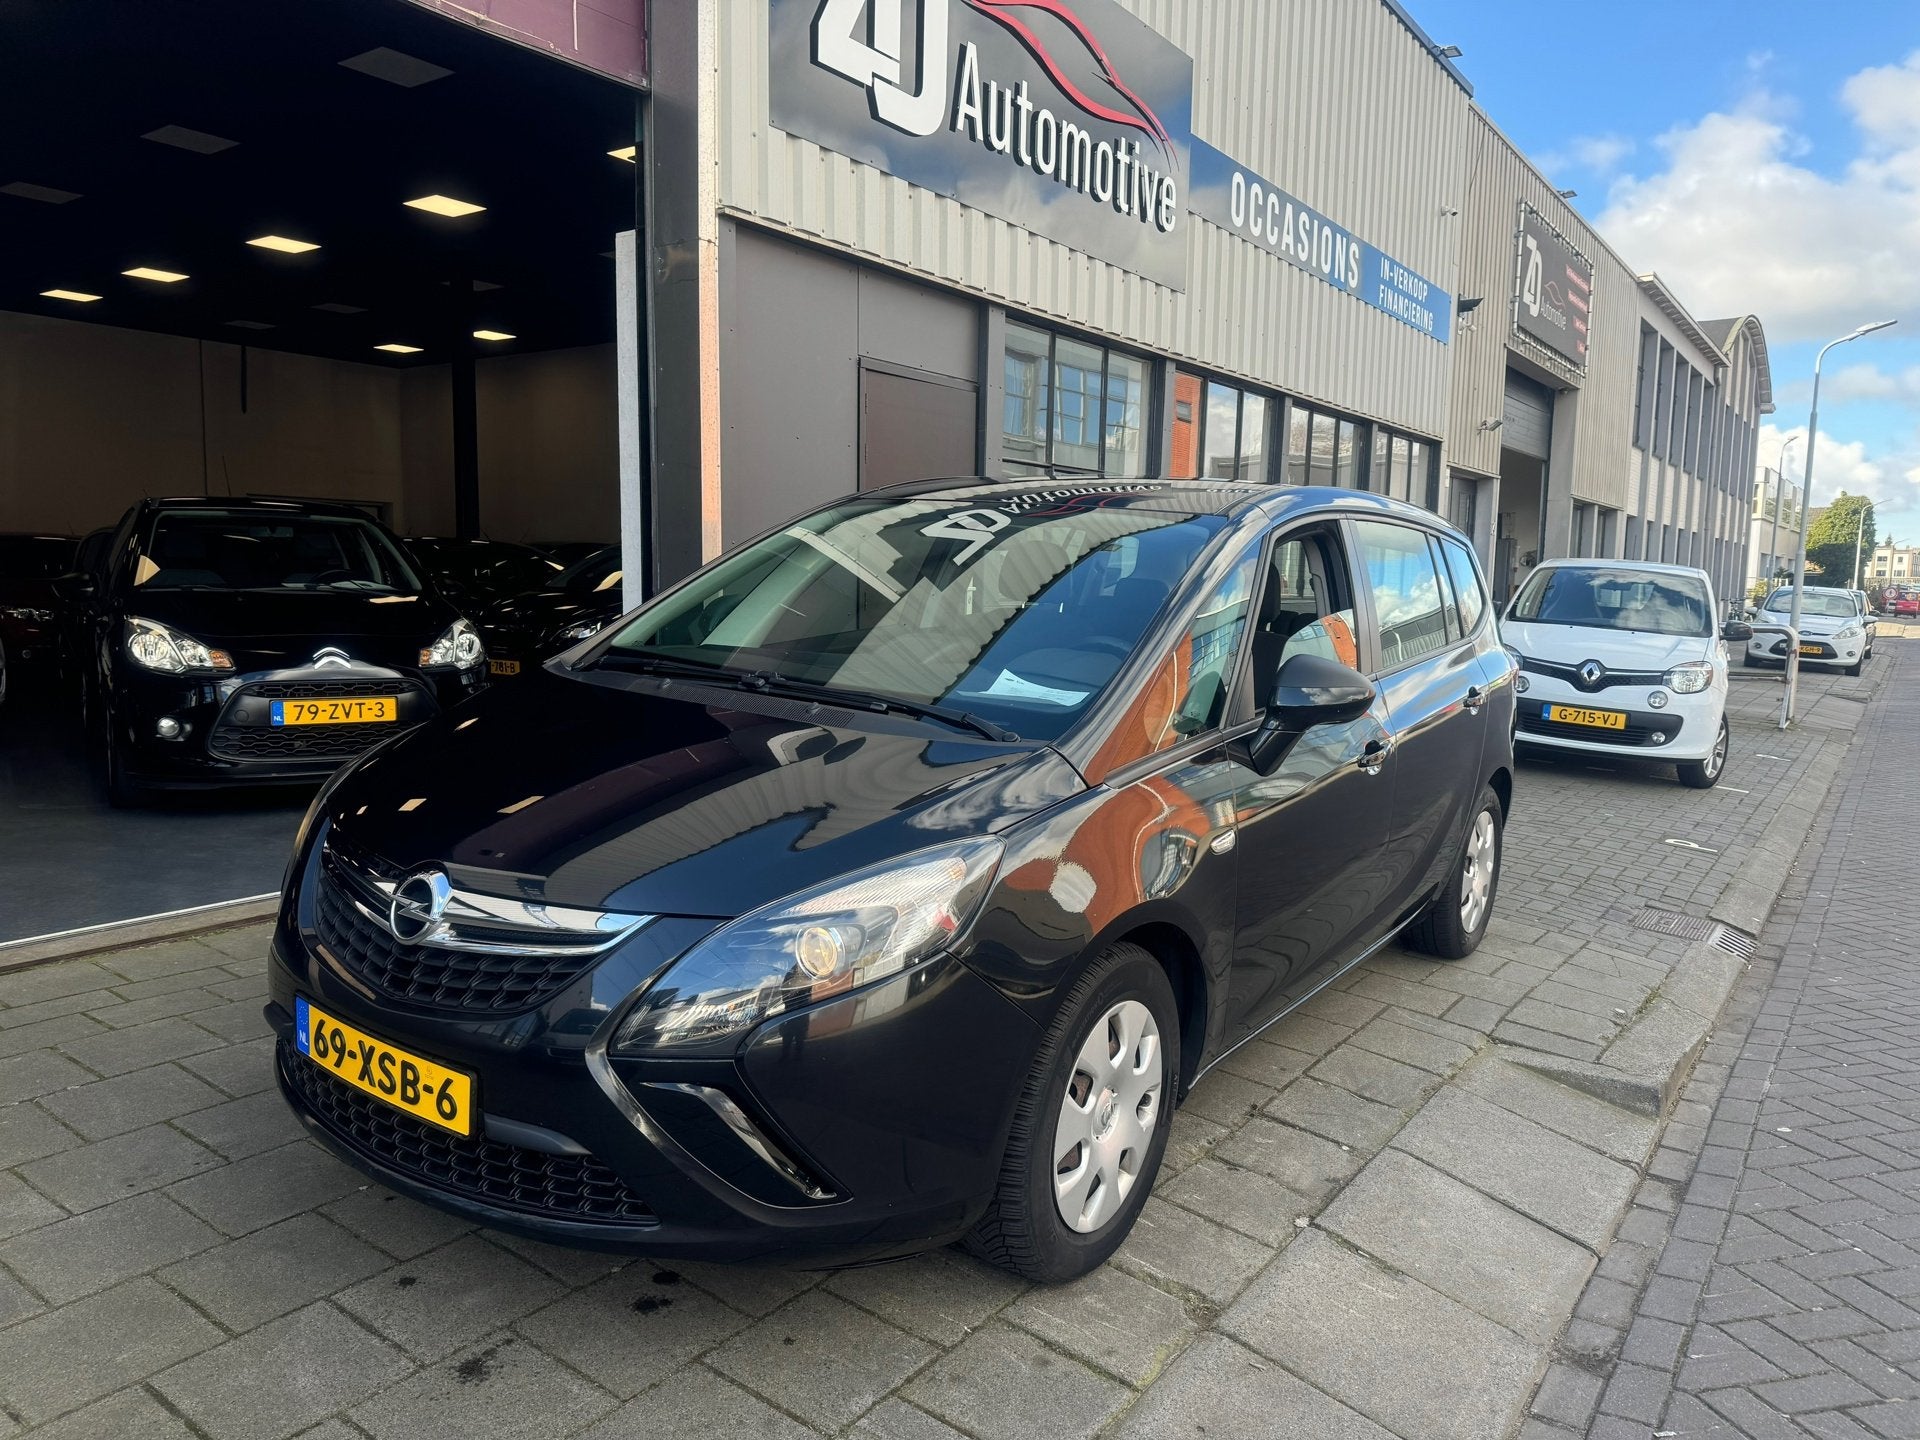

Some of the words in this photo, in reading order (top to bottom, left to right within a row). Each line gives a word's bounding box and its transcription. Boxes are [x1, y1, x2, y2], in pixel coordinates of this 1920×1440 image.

[952, 41, 1177, 233] Automotive
[1231, 171, 1360, 289] OCCASIONS
[1380, 256, 1428, 303] IN-VERKOOP
[1379, 284, 1434, 332] FINANCIERING
[293, 701, 385, 721] 79-ZVT-3
[1558, 708, 1618, 726] G-715-VJ
[299, 1029, 309, 1047] NL
[313, 1018, 458, 1121] 69-XSB-6
